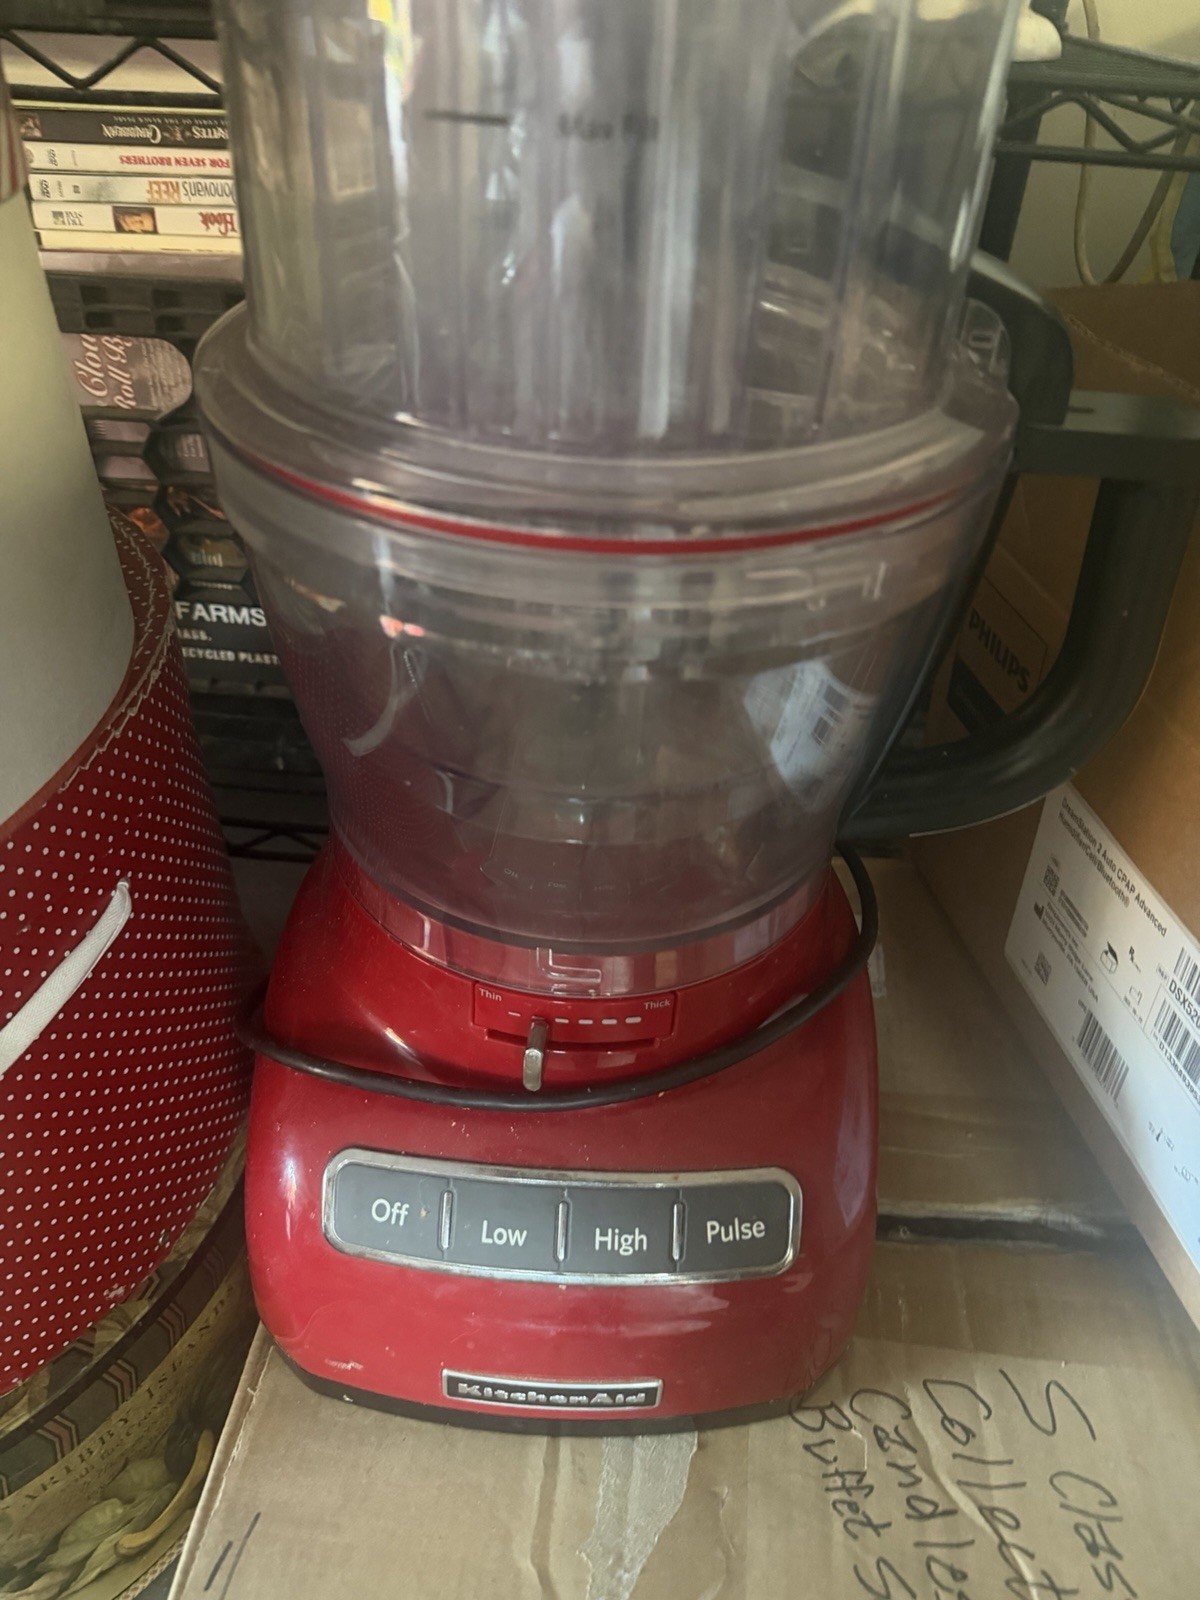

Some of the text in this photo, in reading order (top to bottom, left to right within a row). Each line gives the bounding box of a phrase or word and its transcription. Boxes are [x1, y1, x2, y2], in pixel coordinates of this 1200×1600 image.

[119, 154, 230, 168] FOR SEVEN BROTHERS
[146, 181, 181, 203] REEF
[199, 212, 238, 236] Hook
[107, 364, 137, 410] Roll
[175, 601, 268, 628] FARMS
[969, 607, 1030, 693] PHILIPS
[1101, 848, 1118, 873] Auto
[1116, 867, 1137, 895] CPAP
[1134, 892, 1168, 938] Advanced
[478, 987, 672, 1010] Thin Thick
[370, 1197, 410, 1227] Off
[480, 1219, 528, 1248] Low
[594, 1227, 649, 1256] High
[705, 1216, 767, 1245] Pulse
[457, 1382, 646, 1405] KitchenAid
[998, 1367, 1097, 1442] S
[788, 1396, 893, 1541] Buffet
[849, 1387, 976, 1600] Candle
